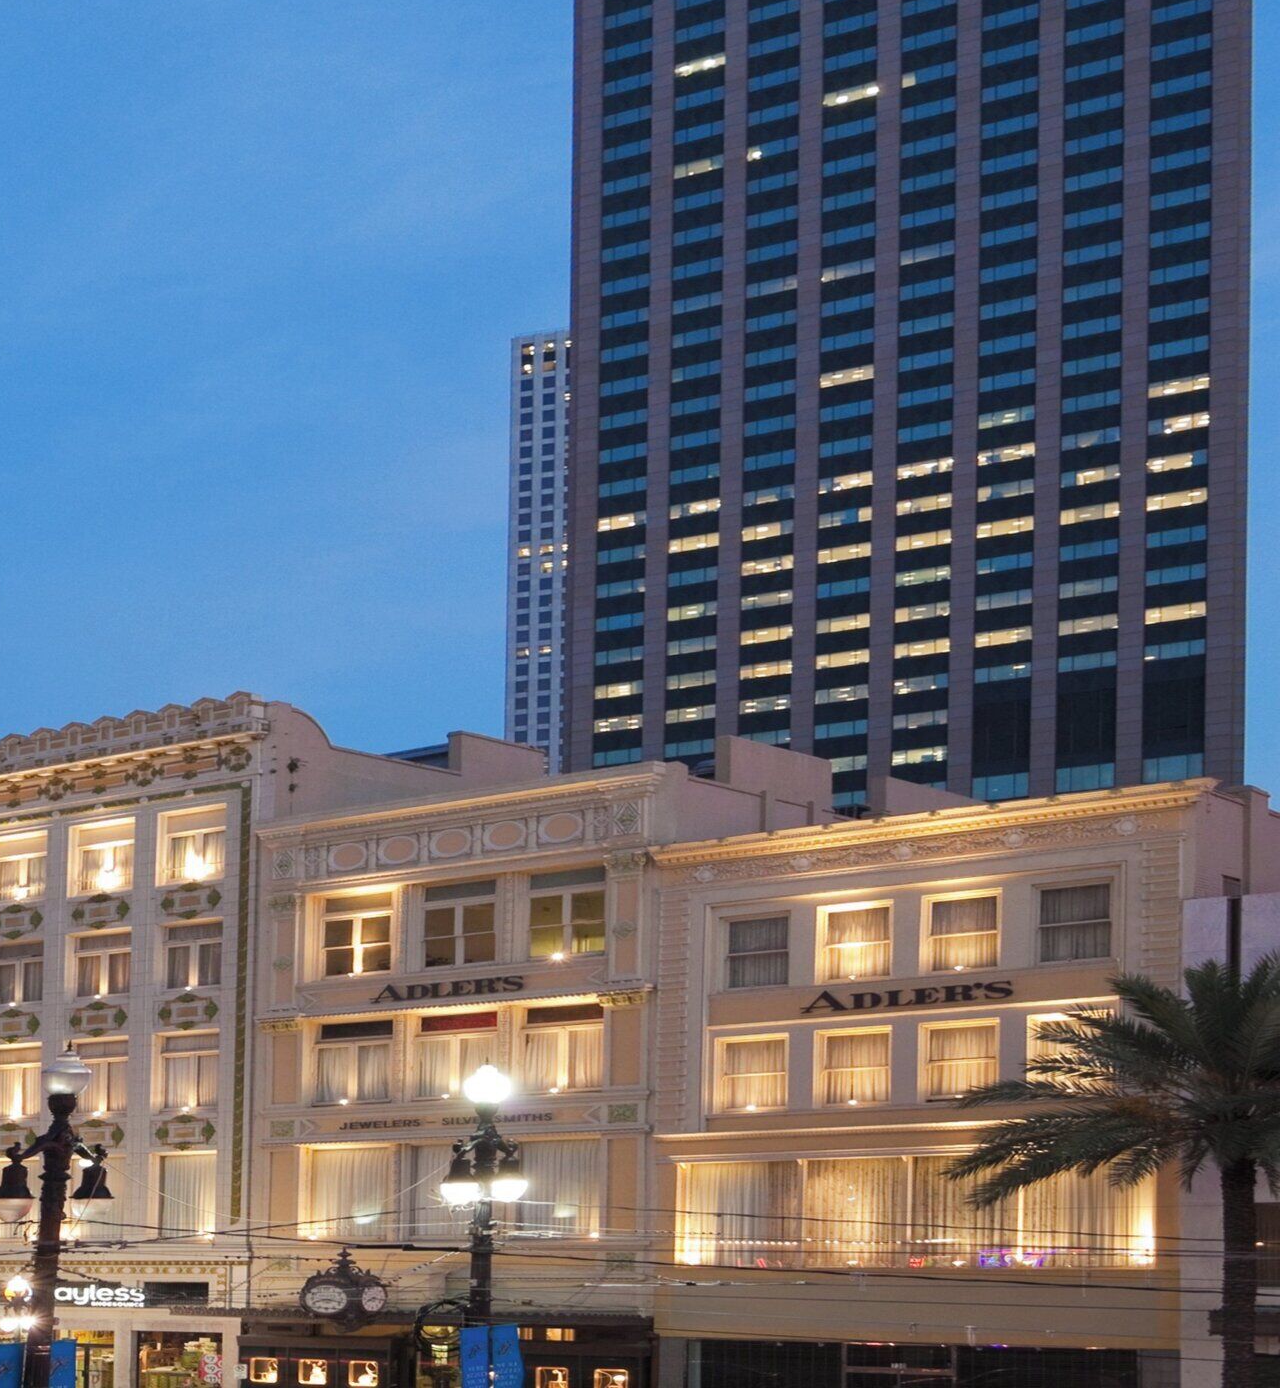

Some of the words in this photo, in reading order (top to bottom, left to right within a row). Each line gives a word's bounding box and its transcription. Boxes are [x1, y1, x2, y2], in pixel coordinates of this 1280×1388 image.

[368, 975, 524, 1004] ADLER'S
[799, 980, 1014, 1014] ADLER'S
[339, 1119, 421, 1130] JEWELERS
[441, 1112, 554, 1126] SILVESMITHS
[53, 1284, 146, 1306] ayless
